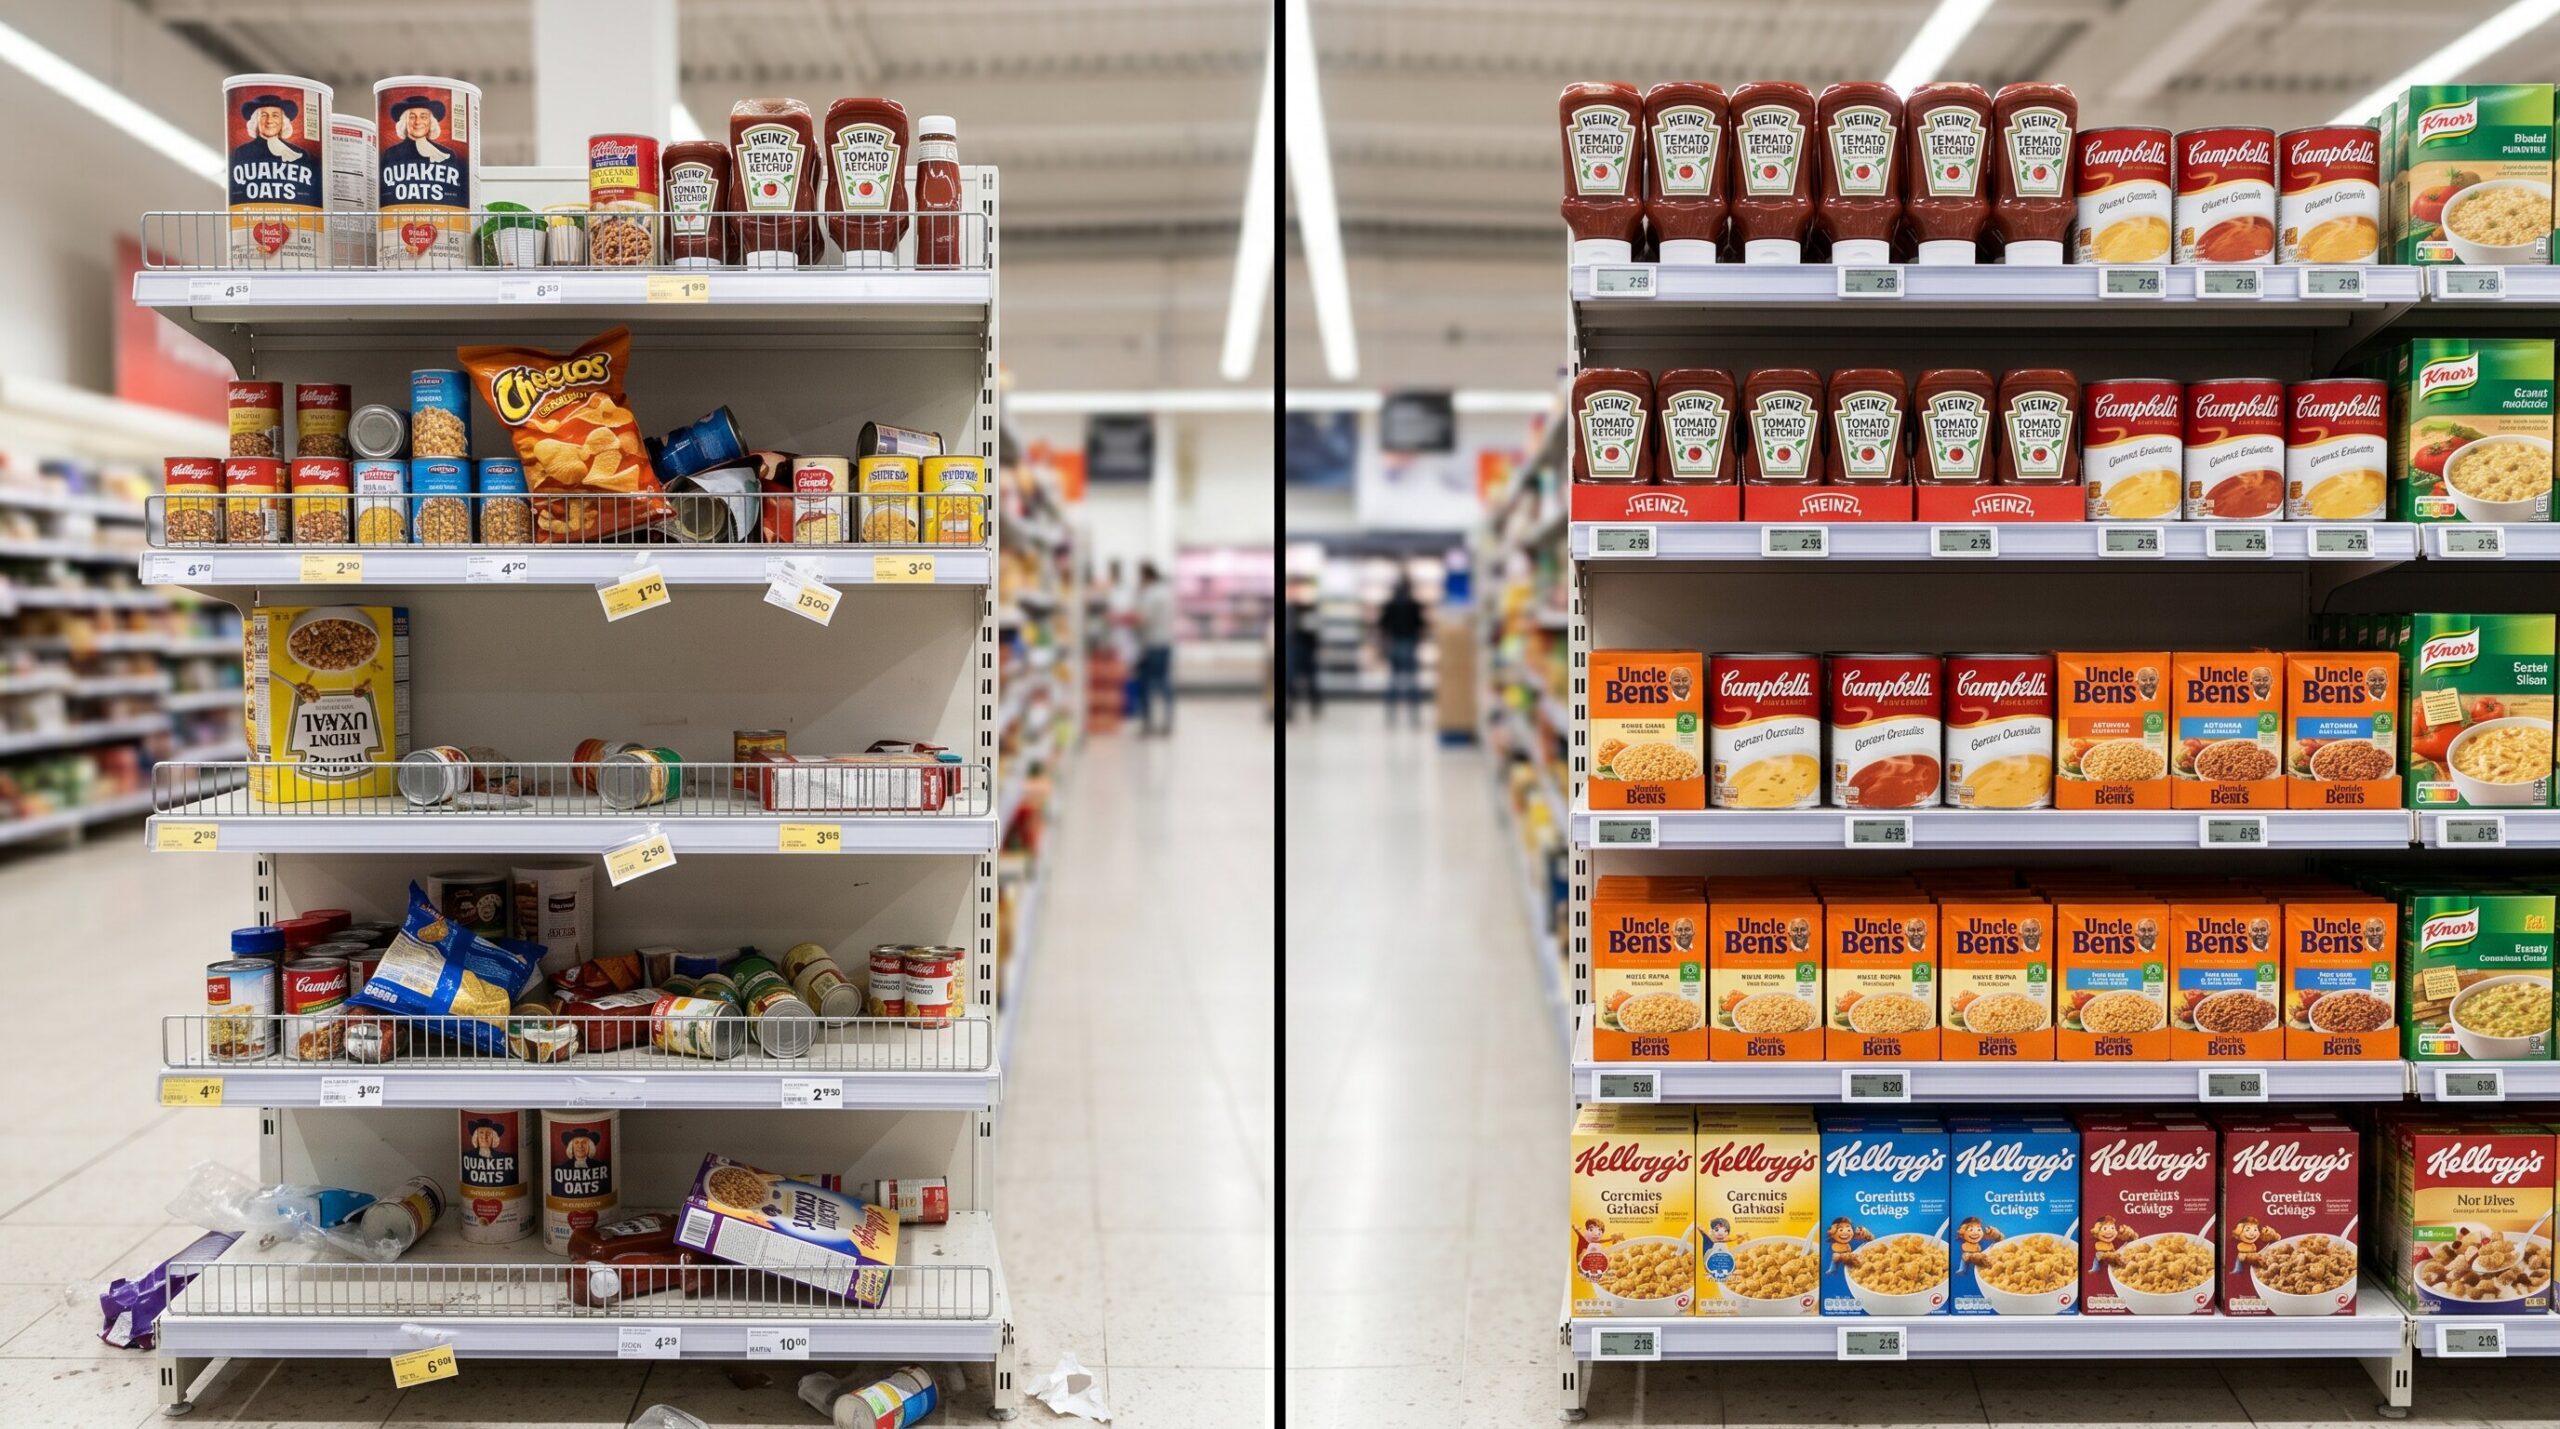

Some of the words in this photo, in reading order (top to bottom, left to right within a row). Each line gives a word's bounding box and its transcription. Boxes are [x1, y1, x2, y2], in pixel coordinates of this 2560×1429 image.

[1582, 114, 1619, 128] HEINZ
[1668, 114, 1704, 128] HEINZ
[1753, 114, 1788, 128] HEINZ
[1844, 115, 1882, 128] HEINZ
[1934, 115, 1972, 129] HEINZ
[2021, 115, 2058, 129] HEINZ
[2421, 111, 2475, 135] Knorr
[751, 132, 789, 146] HEINZ
[1578, 134, 1624, 146] TEMATO
[1664, 134, 1709, 146] TEMATO
[1748, 134, 1794, 146] TEMATO
[1840, 135, 1886, 146] TEMATO
[1930, 135, 1976, 147] TEMATO
[2017, 135, 2062, 147] TEMATO
[843, 151, 889, 162] TOMATO
[1580, 144, 1623, 156] KETCHUP
[2019, 146, 2062, 157] KETCHUP
[233, 161, 313, 186] QUAKER
[383, 162, 460, 187] QUAKER
[246, 182, 297, 200] OATS
[395, 183, 444, 201] OATS
[2422, 366, 2476, 389] Knorr
[1594, 398, 1631, 413] HEINZ
[1677, 398, 1714, 413] HEINZ
[1766, 398, 1802, 413] HEINZ
[1850, 398, 1887, 413] HEINZ
[1938, 398, 1975, 413] HEINZ
[2021, 398, 2058, 413] HEINZ
[1590, 417, 1635, 429] TOMATO
[1673, 417, 1718, 429] TOMATO
[1762, 417, 1806, 429] TOMATO
[1845, 418, 1890, 429] TOMATO
[1934, 418, 1979, 430] TOMATO
[2017, 418, 2062, 430] TOMATO
[1675, 427, 1716, 438] KETCHUP
[1764, 427, 1805, 438] KETCHUP
[1633, 497, 1682, 514] HEINZ
[1807, 497, 1854, 514] HEINZ
[1980, 497, 2027, 514] HEINZ
[2423, 641, 2476, 663] Knorr
[1617, 666, 1667, 683] Uncle
[2084, 666, 2134, 683] Uncle
[2199, 666, 2248, 683] Uncle
[2314, 666, 2364, 683] Uncle
[1605, 680, 1669, 704] Ben's
[2073, 680, 2136, 704] Ben's
[2186, 680, 2250, 704] Ben's
[2302, 680, 2366, 704] Ben's
[1621, 917, 1670, 935] Uncle
[1737, 917, 1786, 935] Uncle
[1854, 917, 1903, 935] Uncle
[1969, 917, 2017, 935] Uncle
[2084, 917, 2133, 935] Uncle
[2197, 917, 2246, 935] Uncle
[2312, 917, 2361, 935] Uncle
[463, 1155, 514, 1171] QUAKER
[1574, 1141, 1693, 1183] Kellogg's
[1699, 1141, 1818, 1183] Kellogg's
[1826, 1140, 1947, 1183] Kellogg's
[1956, 1140, 2076, 1183] Kellogg's
[2089, 1138, 2211, 1182] Kellogg's
[2232, 1140, 2353, 1183] Kellogg's
[2426, 1142, 2545, 1185] Kellogg's
[470, 1170, 505, 1184] OATS
[554, 1165, 608, 1183] QUAKER
[564, 1181, 600, 1195] OATS
